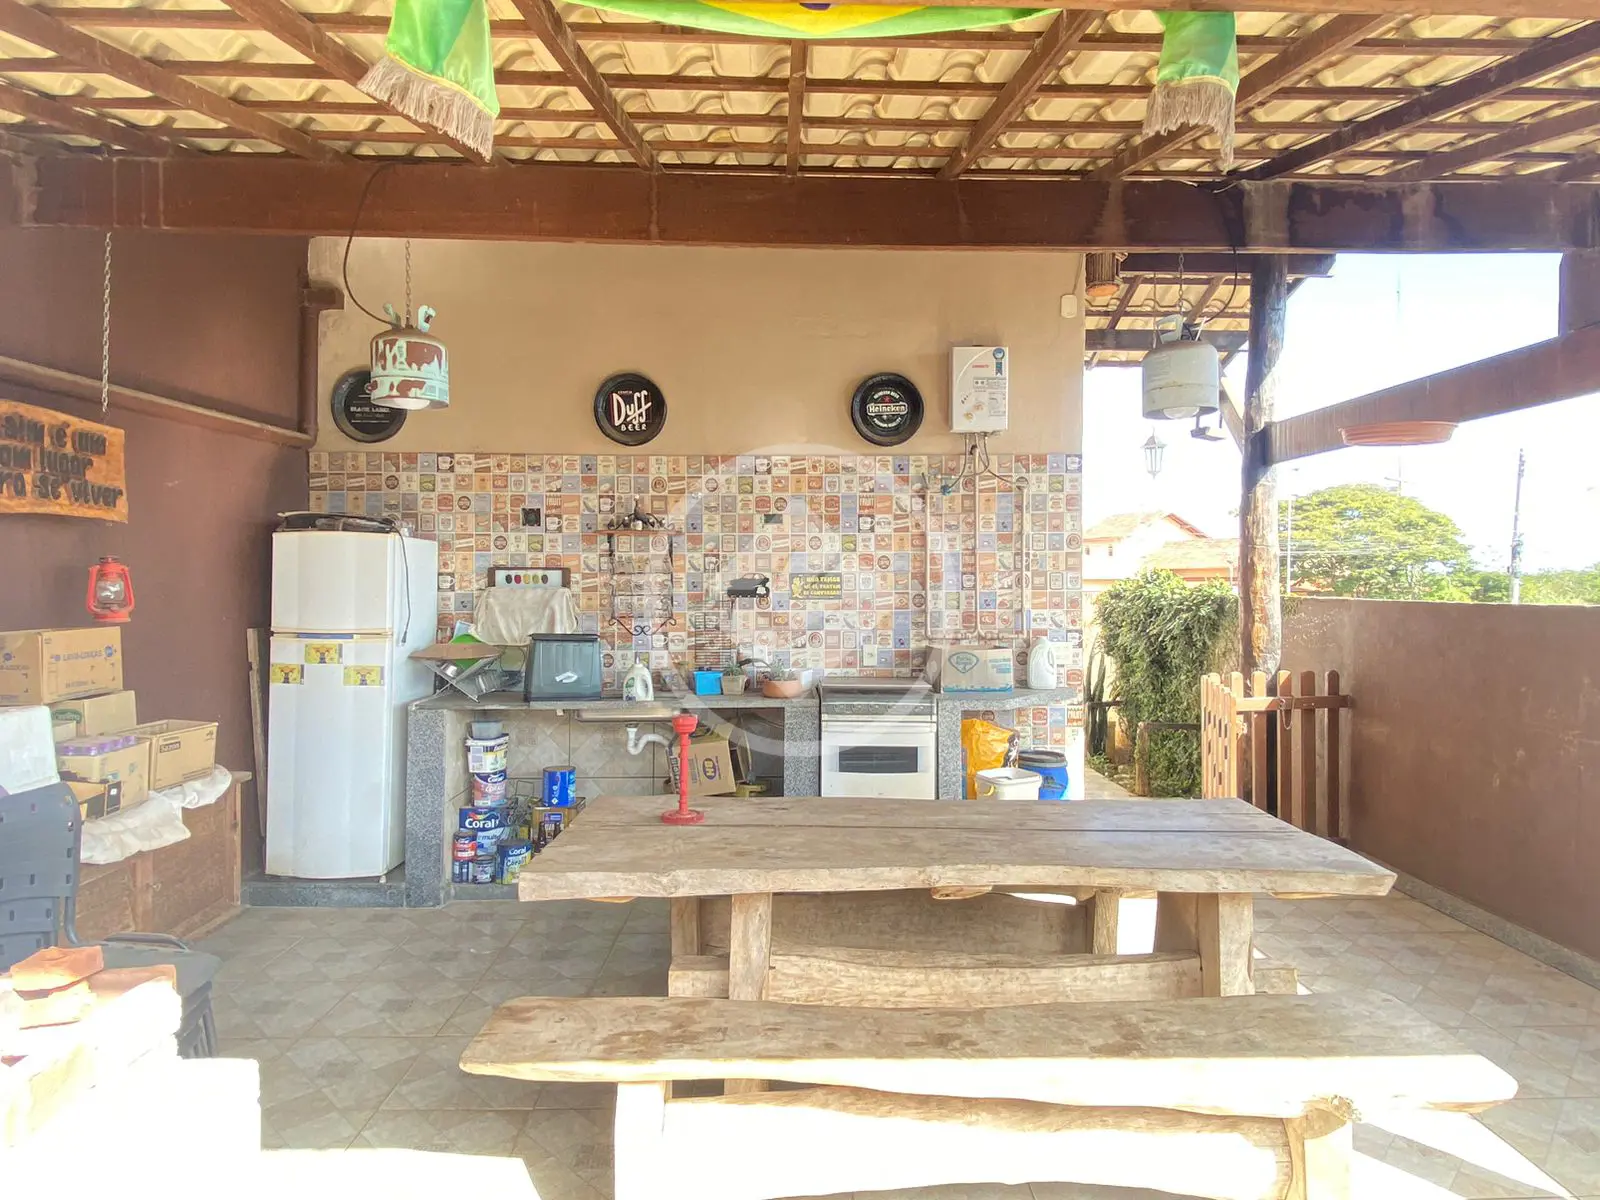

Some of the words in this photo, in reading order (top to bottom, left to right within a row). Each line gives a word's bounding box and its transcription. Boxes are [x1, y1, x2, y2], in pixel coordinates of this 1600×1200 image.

[612, 390, 652, 426] Duff
[868, 404, 906, 413] Heineken
[465, 818, 495, 829] Coral
[509, 846, 527, 855] Coral
